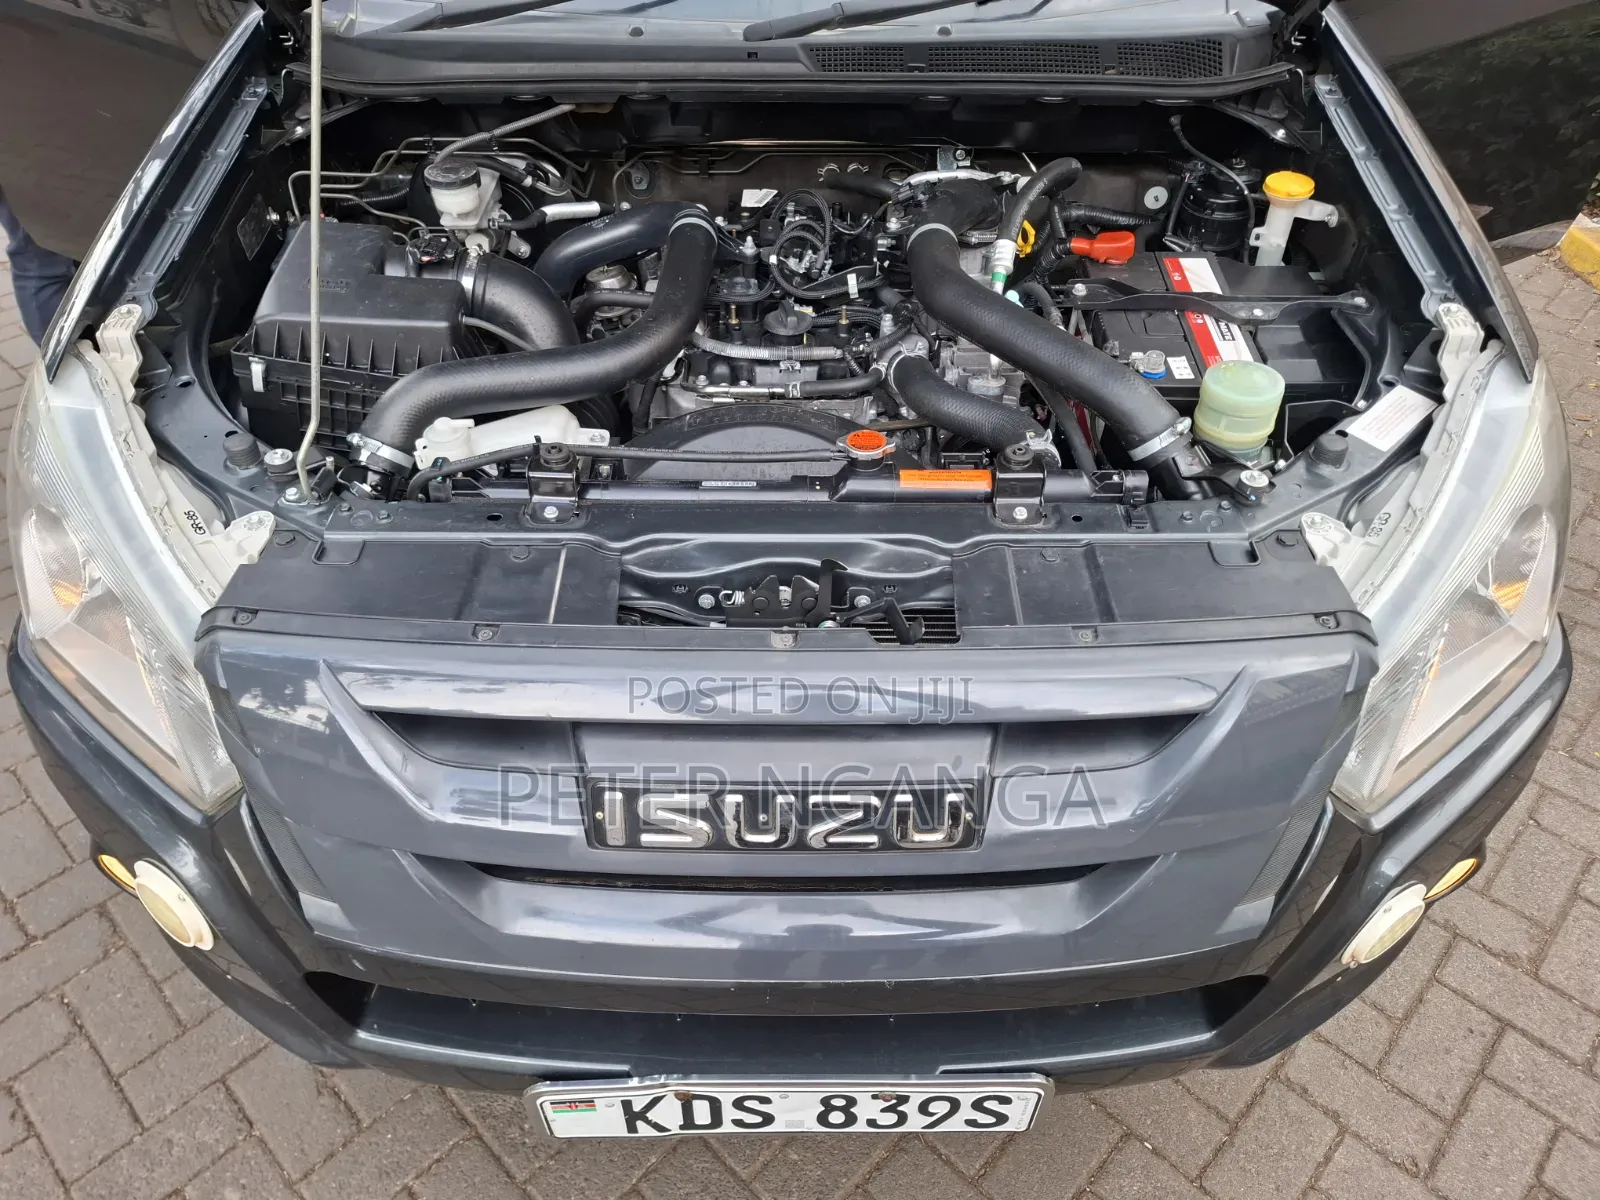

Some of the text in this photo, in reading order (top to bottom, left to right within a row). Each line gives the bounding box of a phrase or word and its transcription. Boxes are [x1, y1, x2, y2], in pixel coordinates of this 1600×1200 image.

[183, 509, 206, 535] GR-85
[603, 790, 964, 849] ISUZU
[621, 1092, 777, 1135] KDS
[814, 1093, 1013, 1130] 839S
